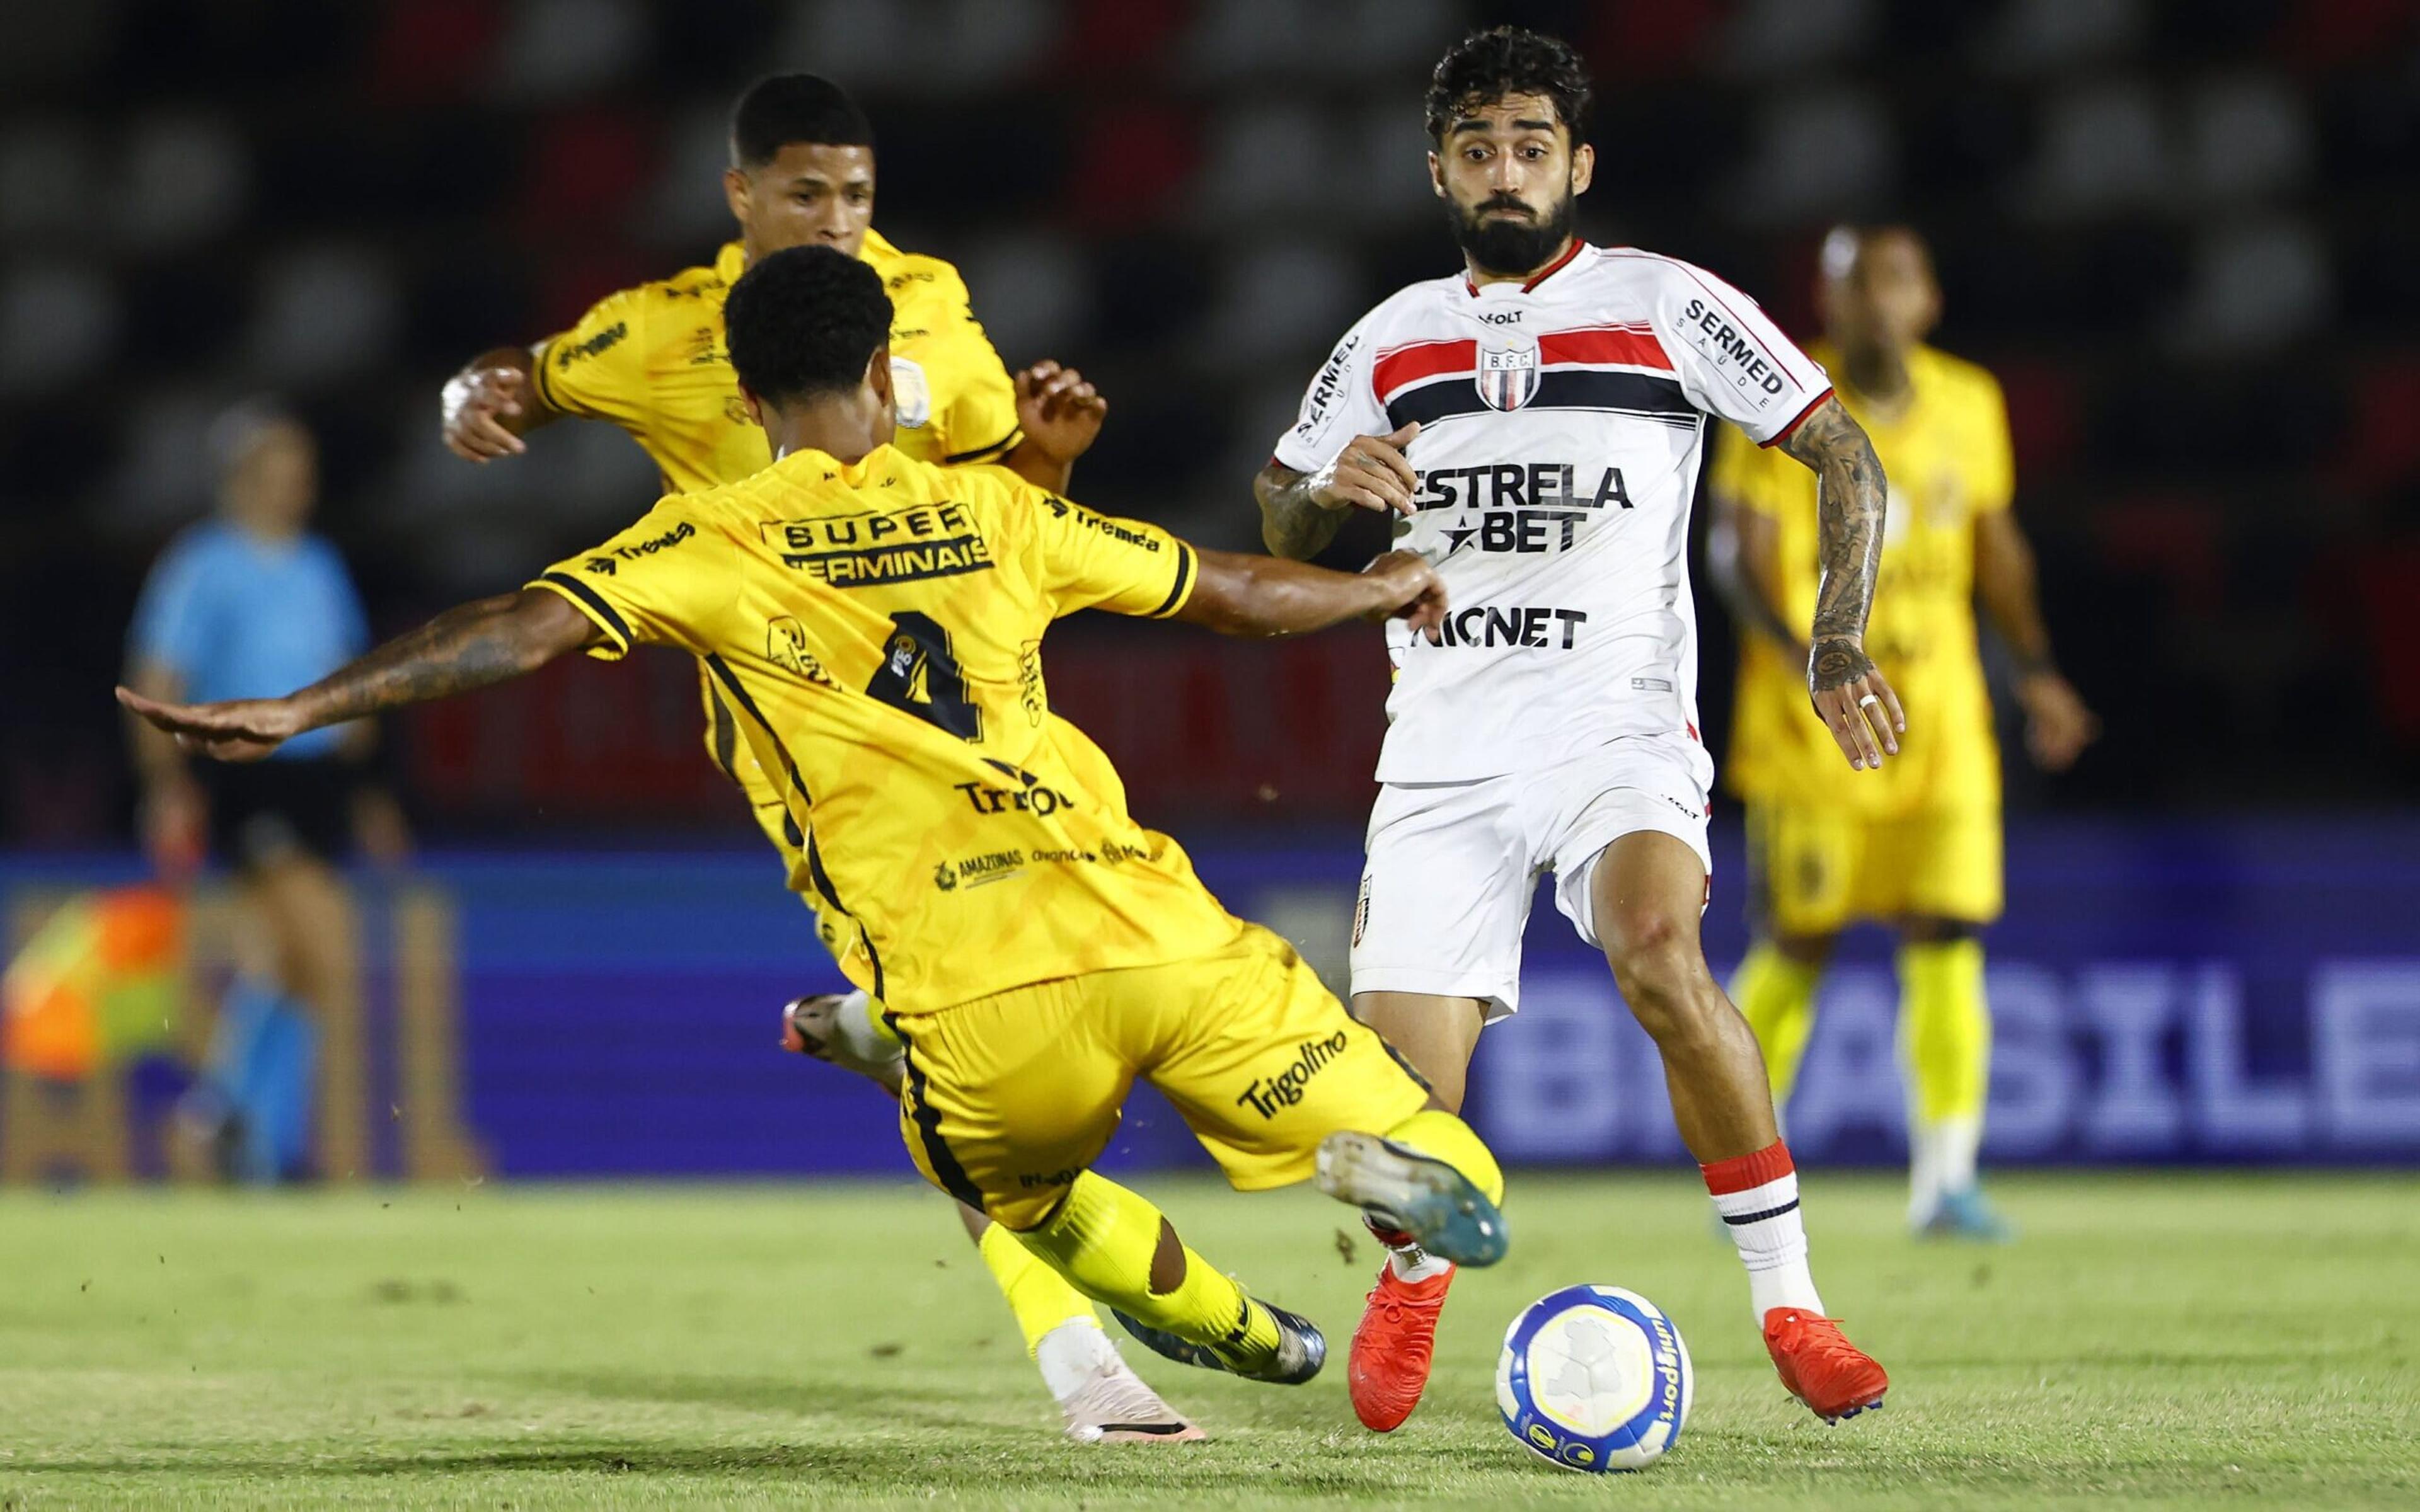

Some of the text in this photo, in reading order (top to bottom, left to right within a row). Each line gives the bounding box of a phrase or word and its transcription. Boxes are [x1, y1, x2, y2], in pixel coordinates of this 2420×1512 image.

[1685, 299, 1783, 394] SERMED
[1414, 463, 1634, 512] ESTRELA
[785, 506, 967, 549] SUPER
[789, 537, 989, 584] ERMINAIS
[1481, 510, 1587, 553] BET
[865, 610, 984, 745] 4
[1236, 1029, 1347, 1121] Trigolino
[1478, 964, 2420, 1160] BASILE
